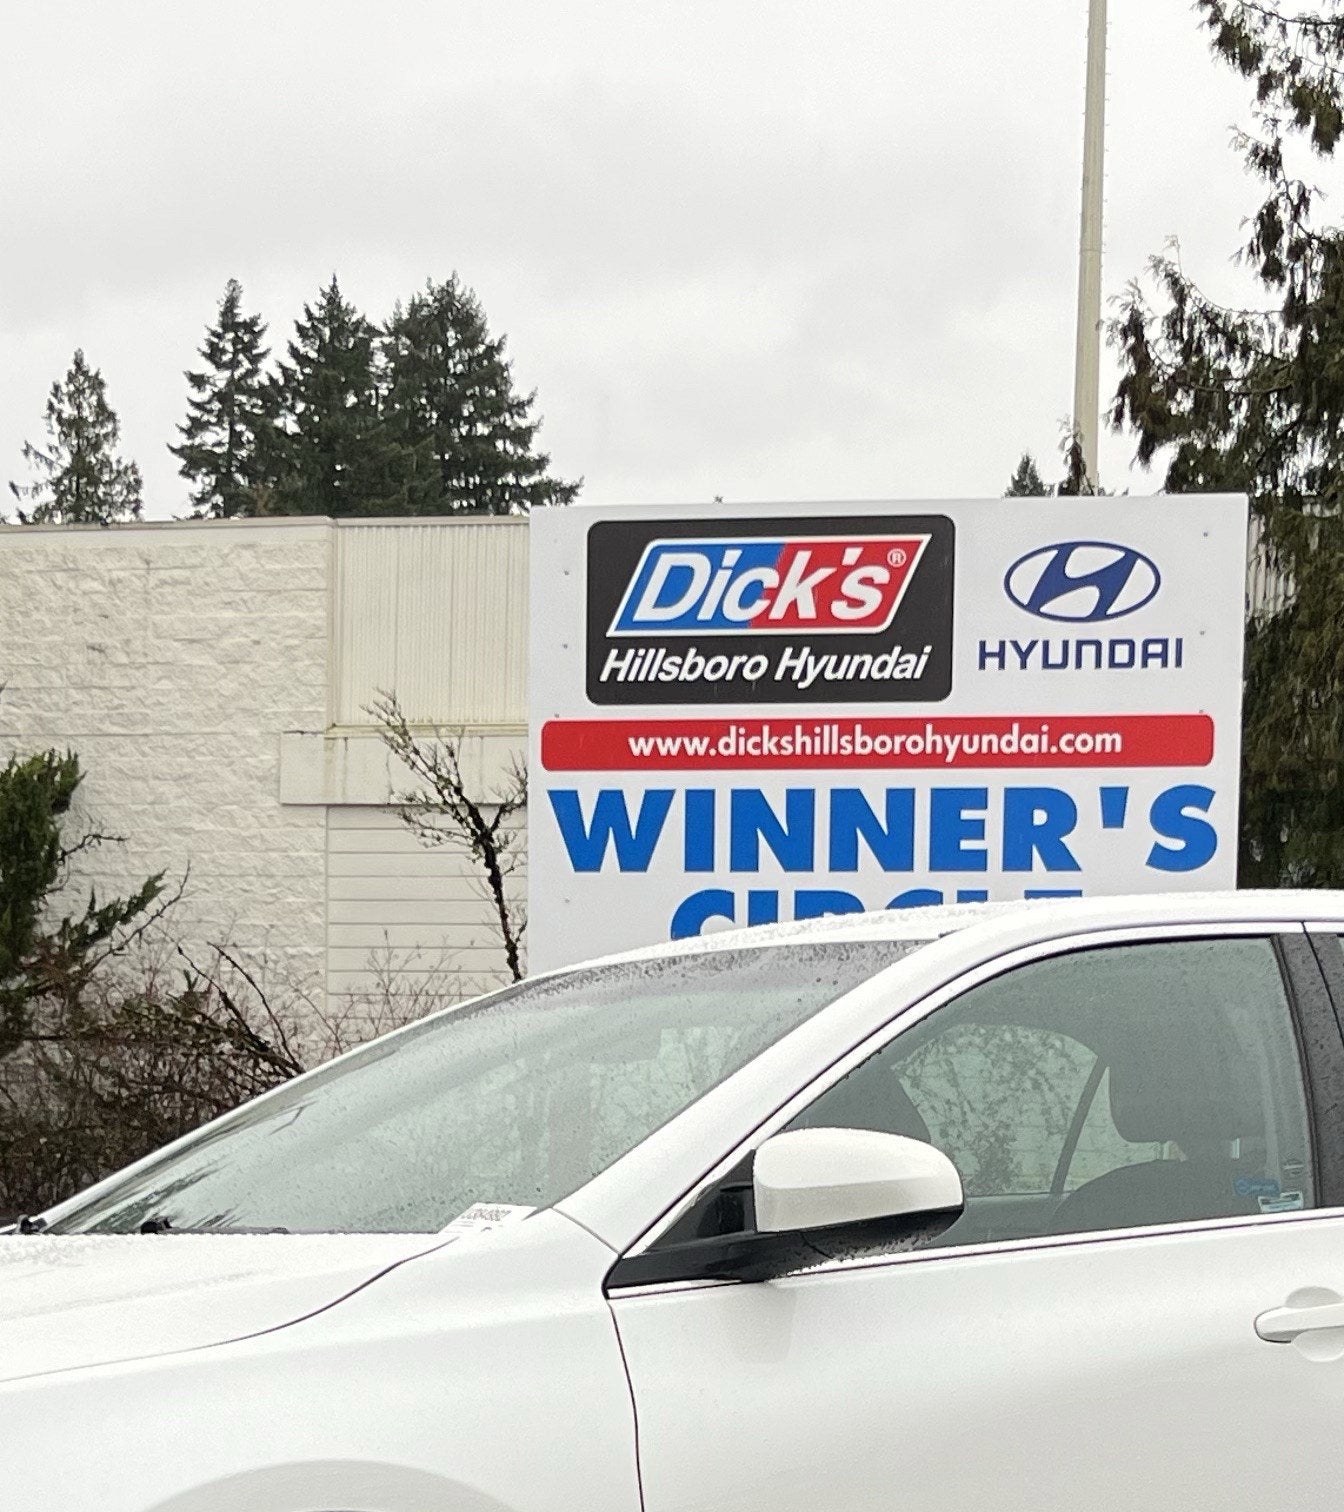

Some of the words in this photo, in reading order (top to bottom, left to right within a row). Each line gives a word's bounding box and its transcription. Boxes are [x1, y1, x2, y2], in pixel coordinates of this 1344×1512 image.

[599, 647, 769, 682] Hillsboro
[773, 645, 933, 689] Hyundai
[978, 638, 1183, 670] HYUNDAI
[628, 723, 1123, 762] www.dickshillsborohyundai.com
[548, 784, 1218, 873] WINNER'S
